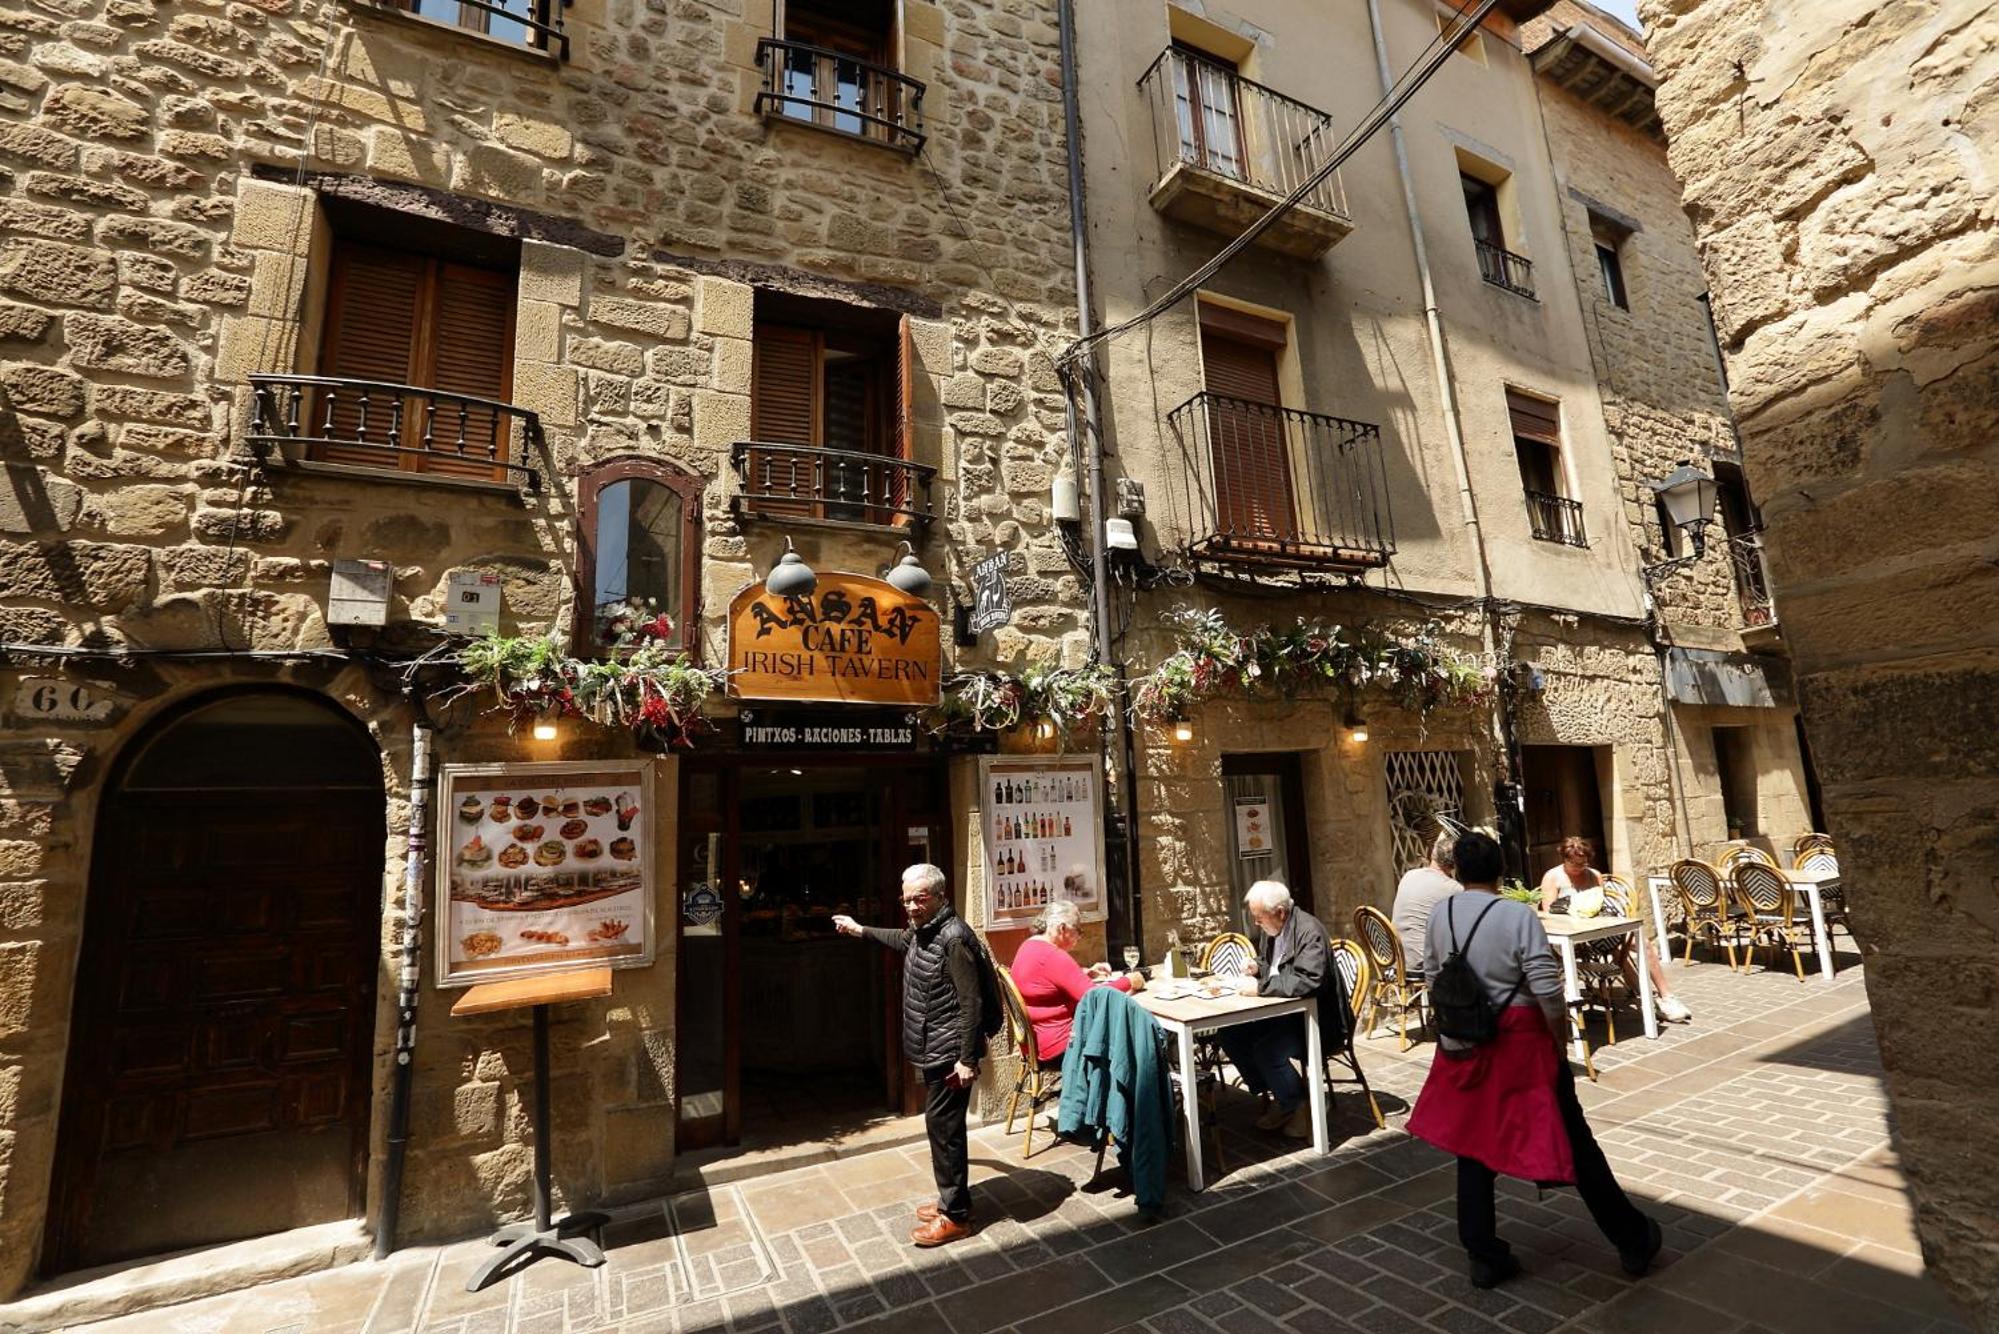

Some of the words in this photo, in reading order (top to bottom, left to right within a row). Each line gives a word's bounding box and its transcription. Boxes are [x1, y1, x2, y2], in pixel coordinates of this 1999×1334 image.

[802, 625, 872, 655] CAFE
[744, 652, 814, 676] IRISH
[826, 655, 927, 681] TAVERN
[868, 728, 913, 743] TABLAS
